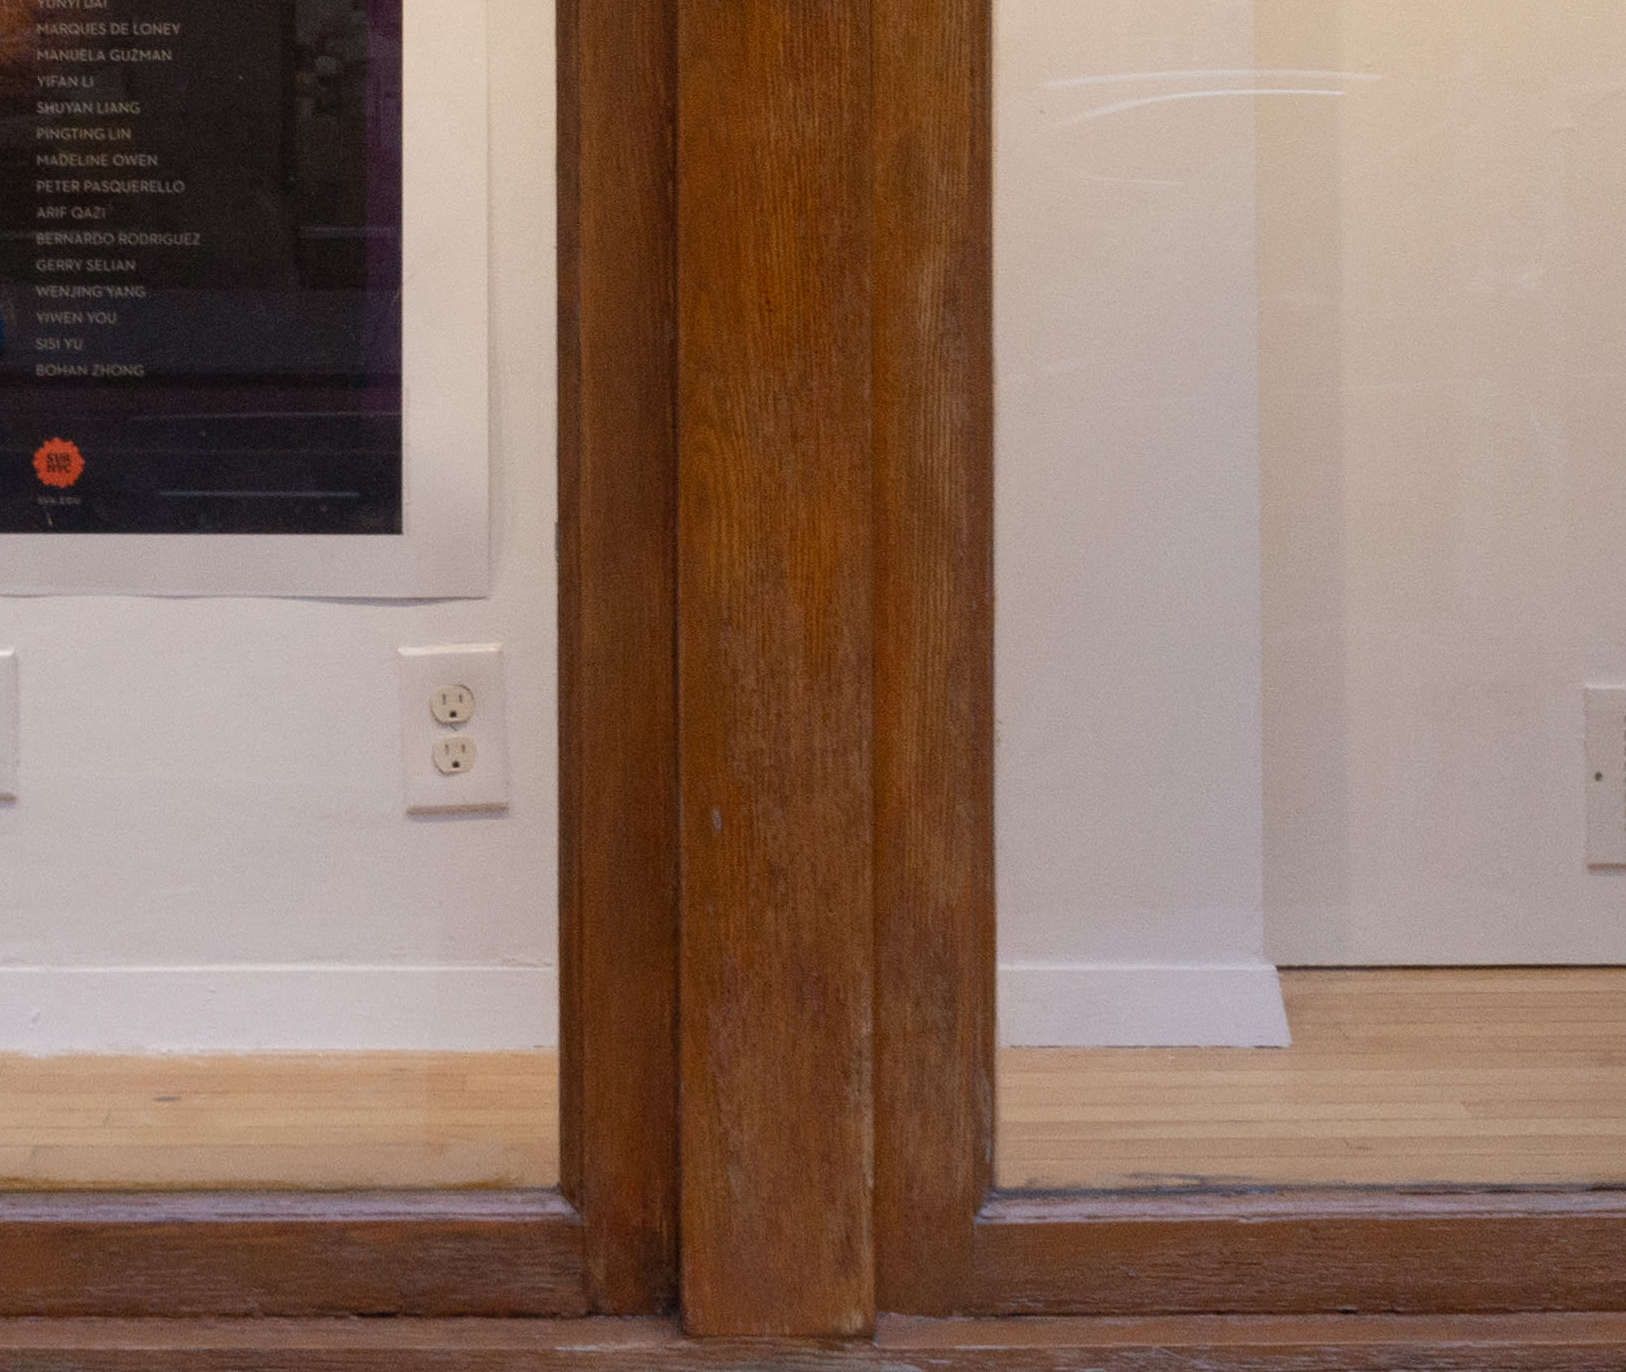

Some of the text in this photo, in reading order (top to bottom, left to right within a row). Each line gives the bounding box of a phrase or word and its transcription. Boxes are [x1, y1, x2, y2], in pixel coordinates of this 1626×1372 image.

[36, 23, 181, 36] MARQUES DE LONEY
[37, 49, 172, 61] MANUELA GUZMAN
[37, 75, 94, 88] YIFAN LI
[37, 102, 141, 114] SHUYAN LIANG
[37, 128, 131, 140] PINGTING LIN
[36, 154, 158, 166] MADELINE OWEN
[36, 180, 186, 193] PETER PASQUERELLO
[37, 207, 106, 219] ARIF QAZI
[37, 233, 201, 245] BERNARDO RODRIGUEZ
[36, 259, 136, 272] GERRY SELIAN
[36, 286, 146, 298] WENJING YANG
[36, 312, 117, 324] YIWEN YOU
[36, 338, 83, 350] SISI YU
[36, 364, 145, 377] BOHAN ZHONG
